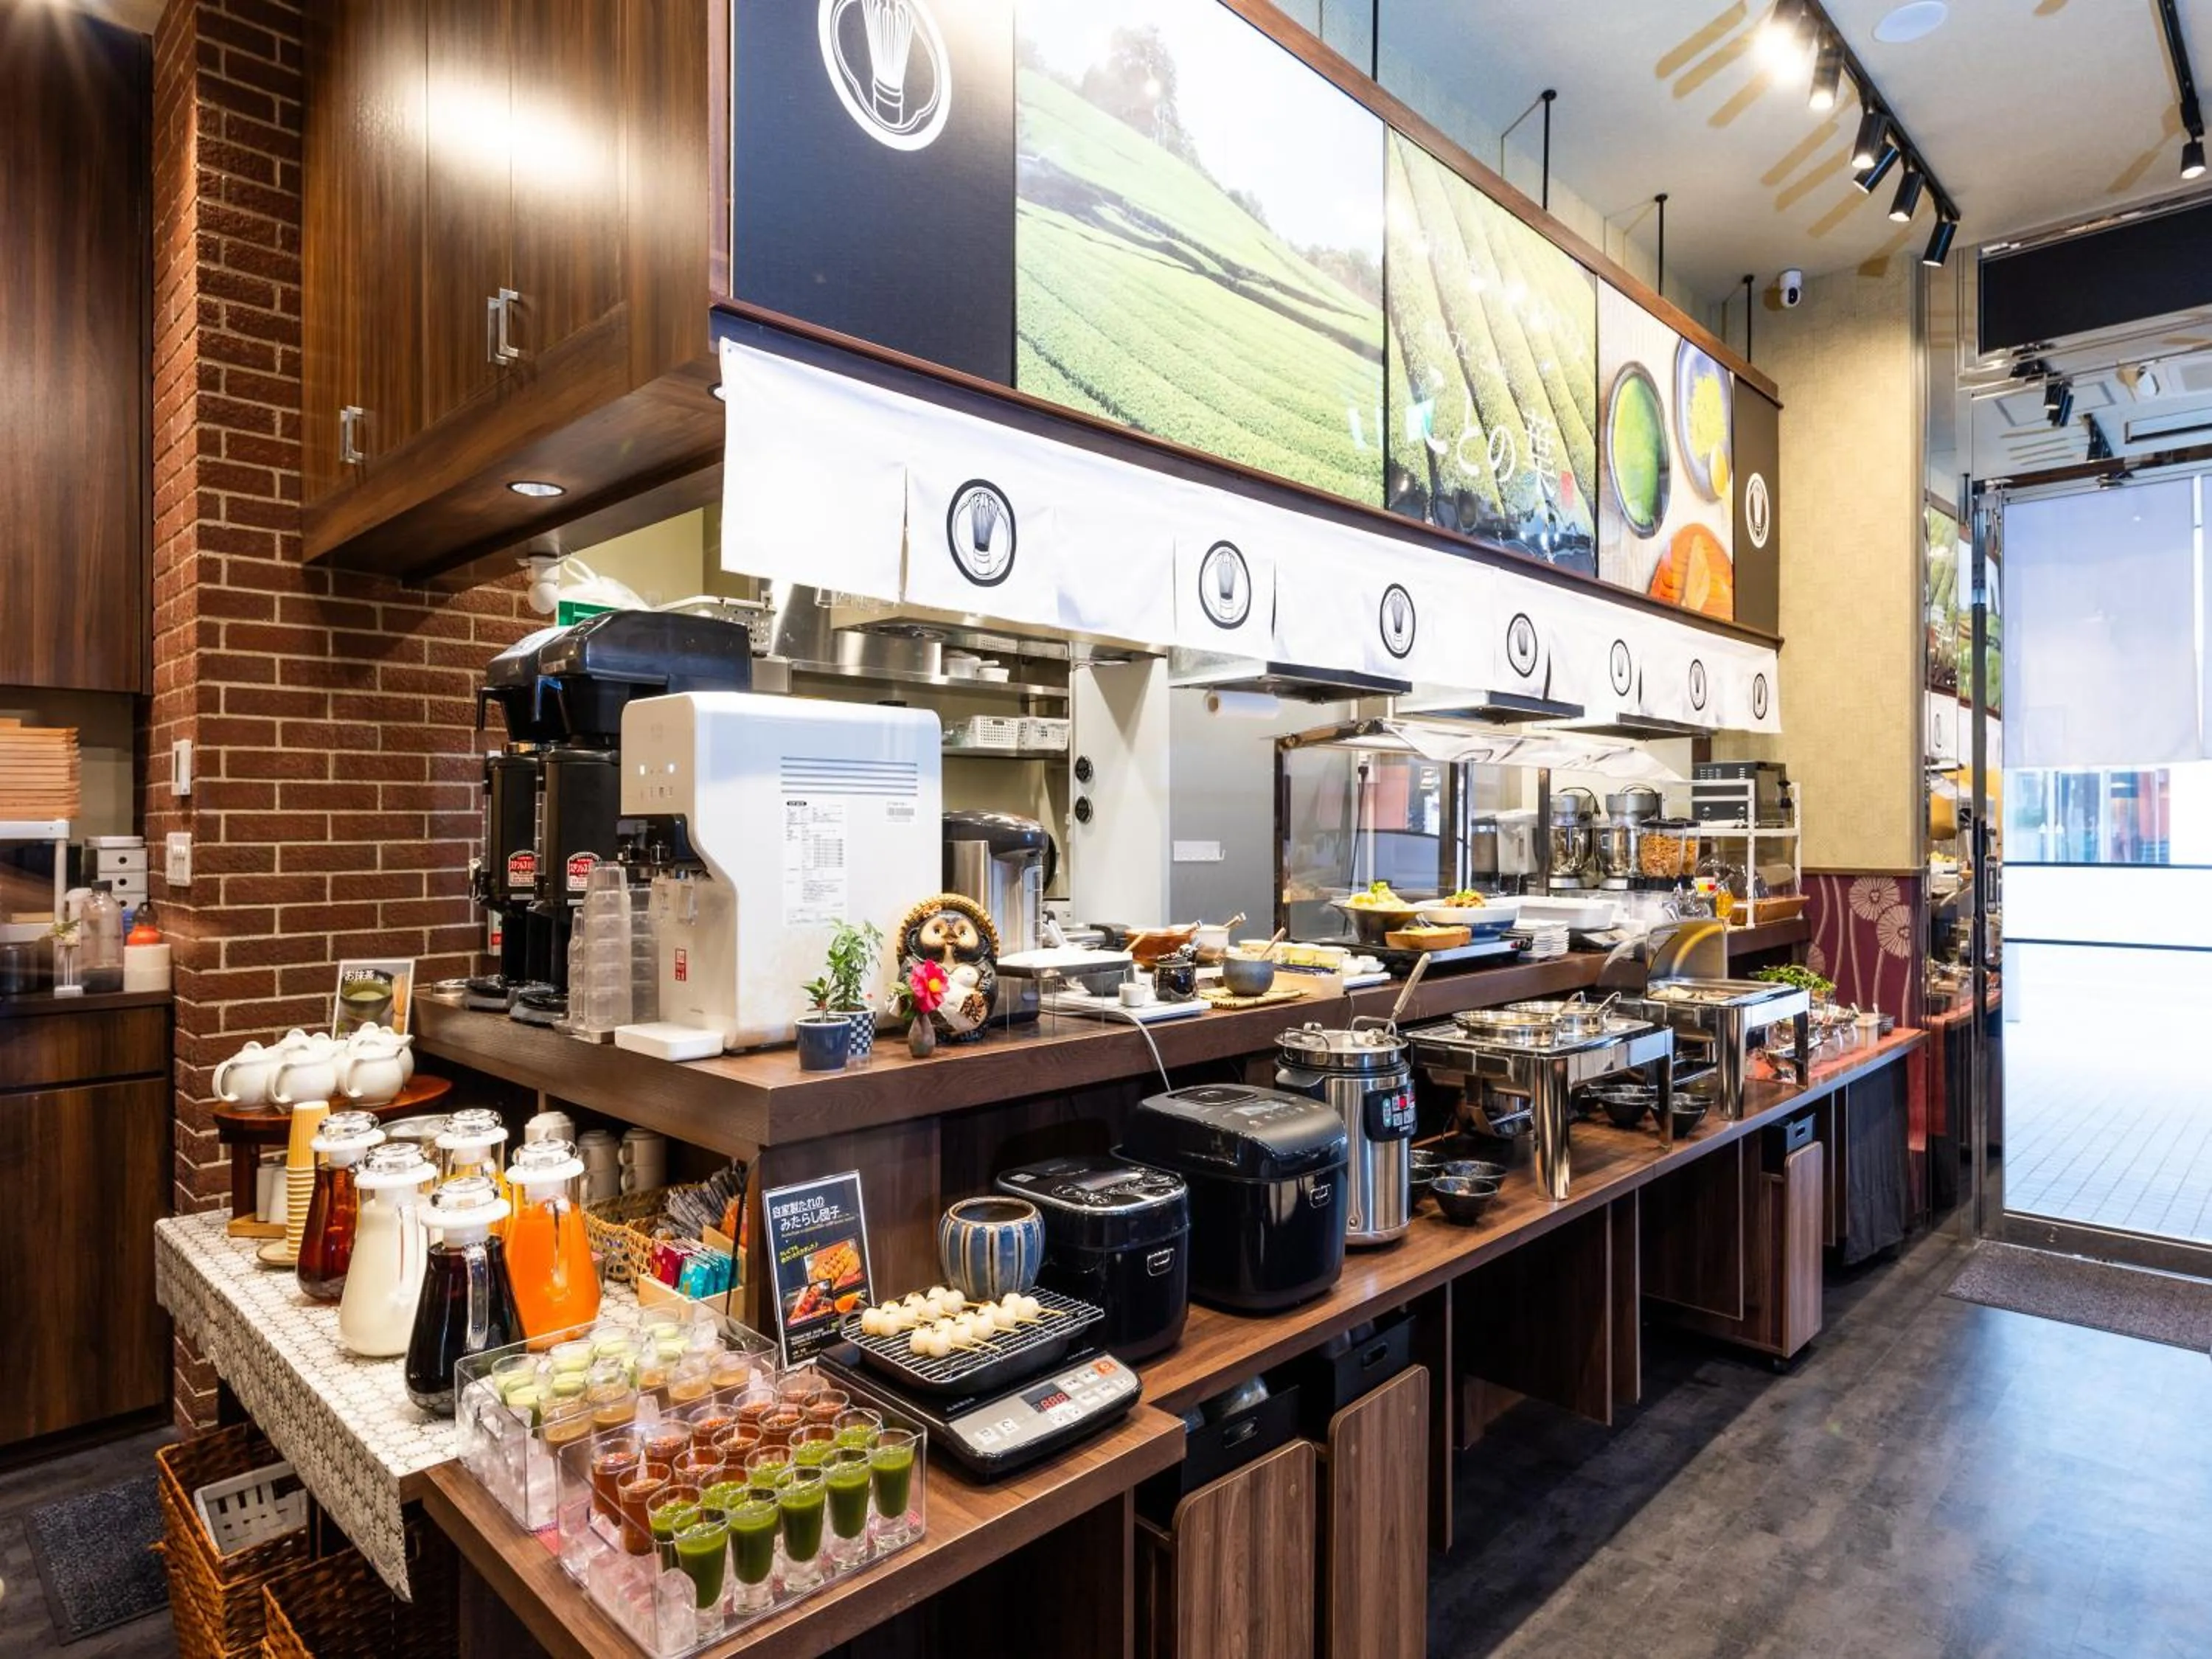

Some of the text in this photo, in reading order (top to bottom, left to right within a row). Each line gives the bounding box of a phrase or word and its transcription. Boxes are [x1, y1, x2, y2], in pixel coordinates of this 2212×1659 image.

[772, 1195, 824, 1218] 自家製たれの
[781, 1206, 840, 1231] みたらし団子
